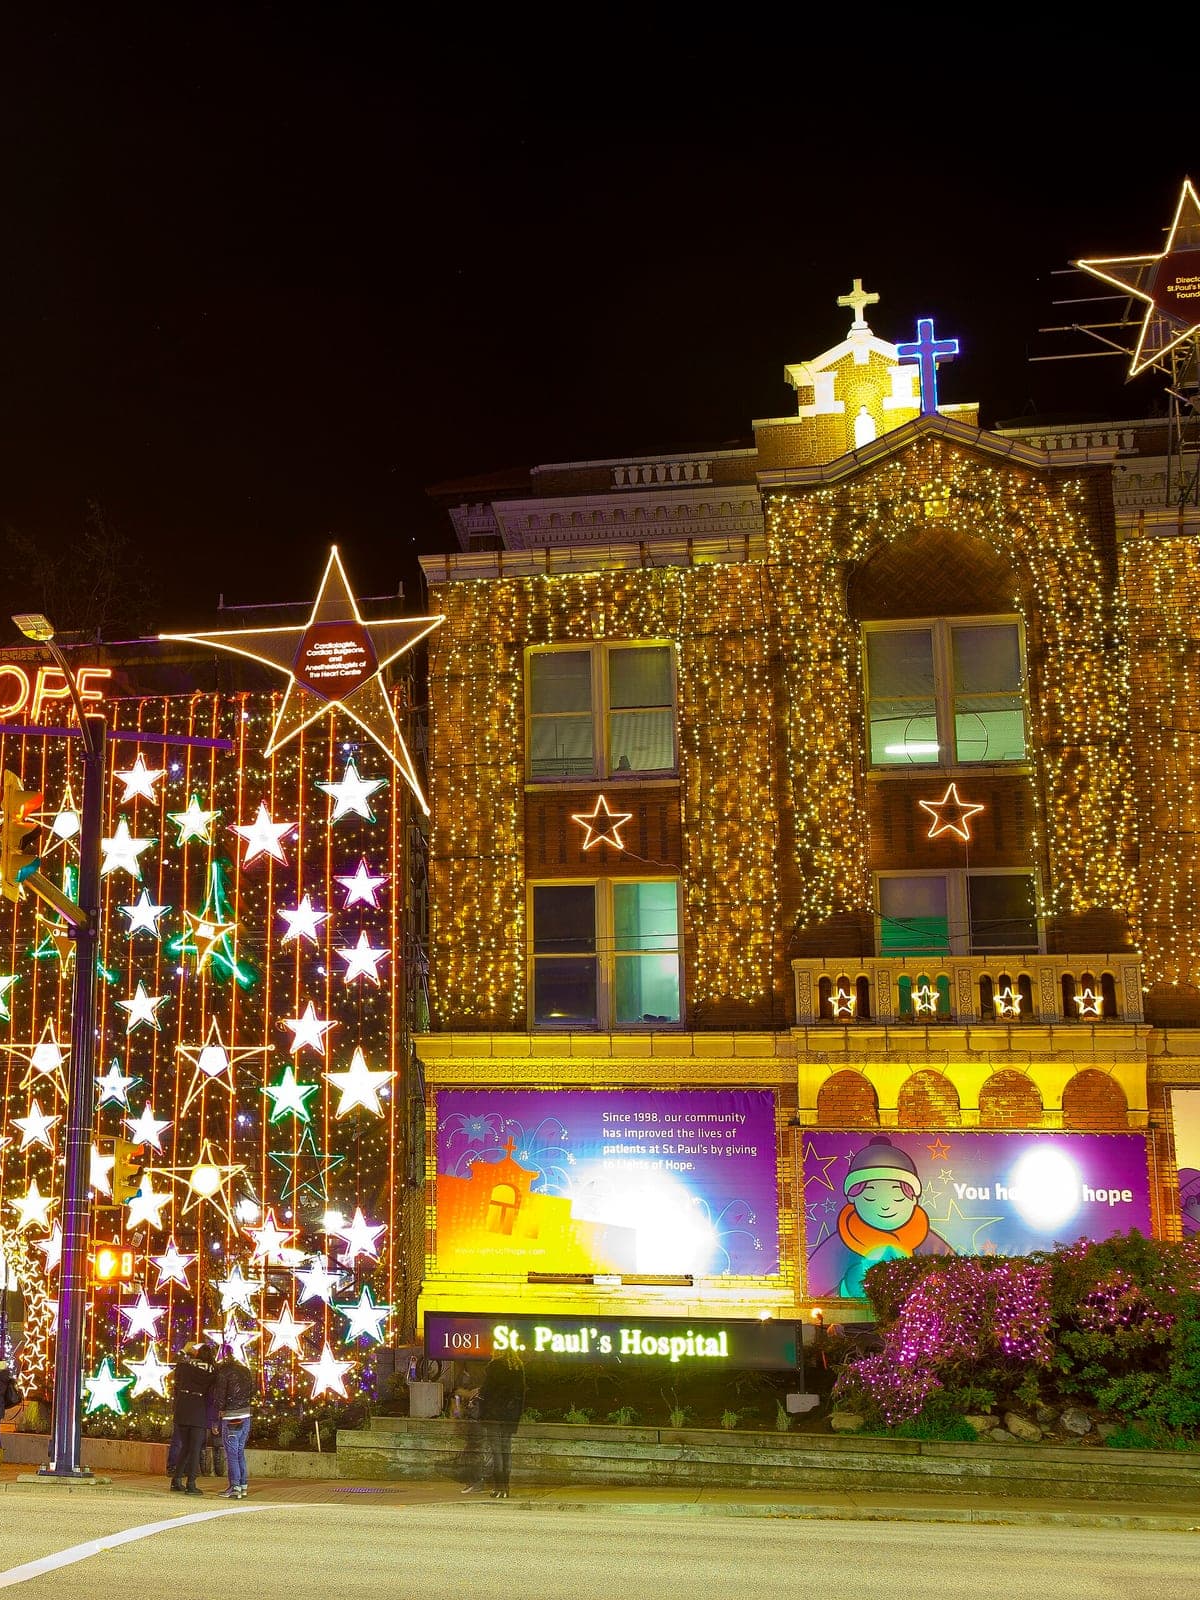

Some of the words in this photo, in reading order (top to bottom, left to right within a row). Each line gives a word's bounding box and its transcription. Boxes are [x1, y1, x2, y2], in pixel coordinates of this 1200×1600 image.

[602, 1112, 631, 1122] Since
[633, 1112, 661, 1124] 1998,
[664, 1114, 682, 1122] our
[684, 1112, 746, 1125] community
[602, 1127, 621, 1138] has
[624, 1127, 674, 1140] improved
[677, 1128, 695, 1138] the
[698, 1128, 722, 1138] lives
[725, 1128, 737, 1138] of
[602, 1143, 646, 1155] patients
[649, 1144, 660, 1154] at
[711, 1144, 723, 1156] by
[725, 1144, 758, 1157] giving
[652, 1160, 663, 1170] of
[666, 1160, 696, 1172] Hope.
[953, 1182, 991, 1201] You
[1082, 1184, 1133, 1207] hope
[442, 1332, 481, 1349] 1081
[493, 1325, 526, 1352] St.
[534, 1326, 613, 1354] Paul's
[619, 1329, 729, 1363] Hospital
